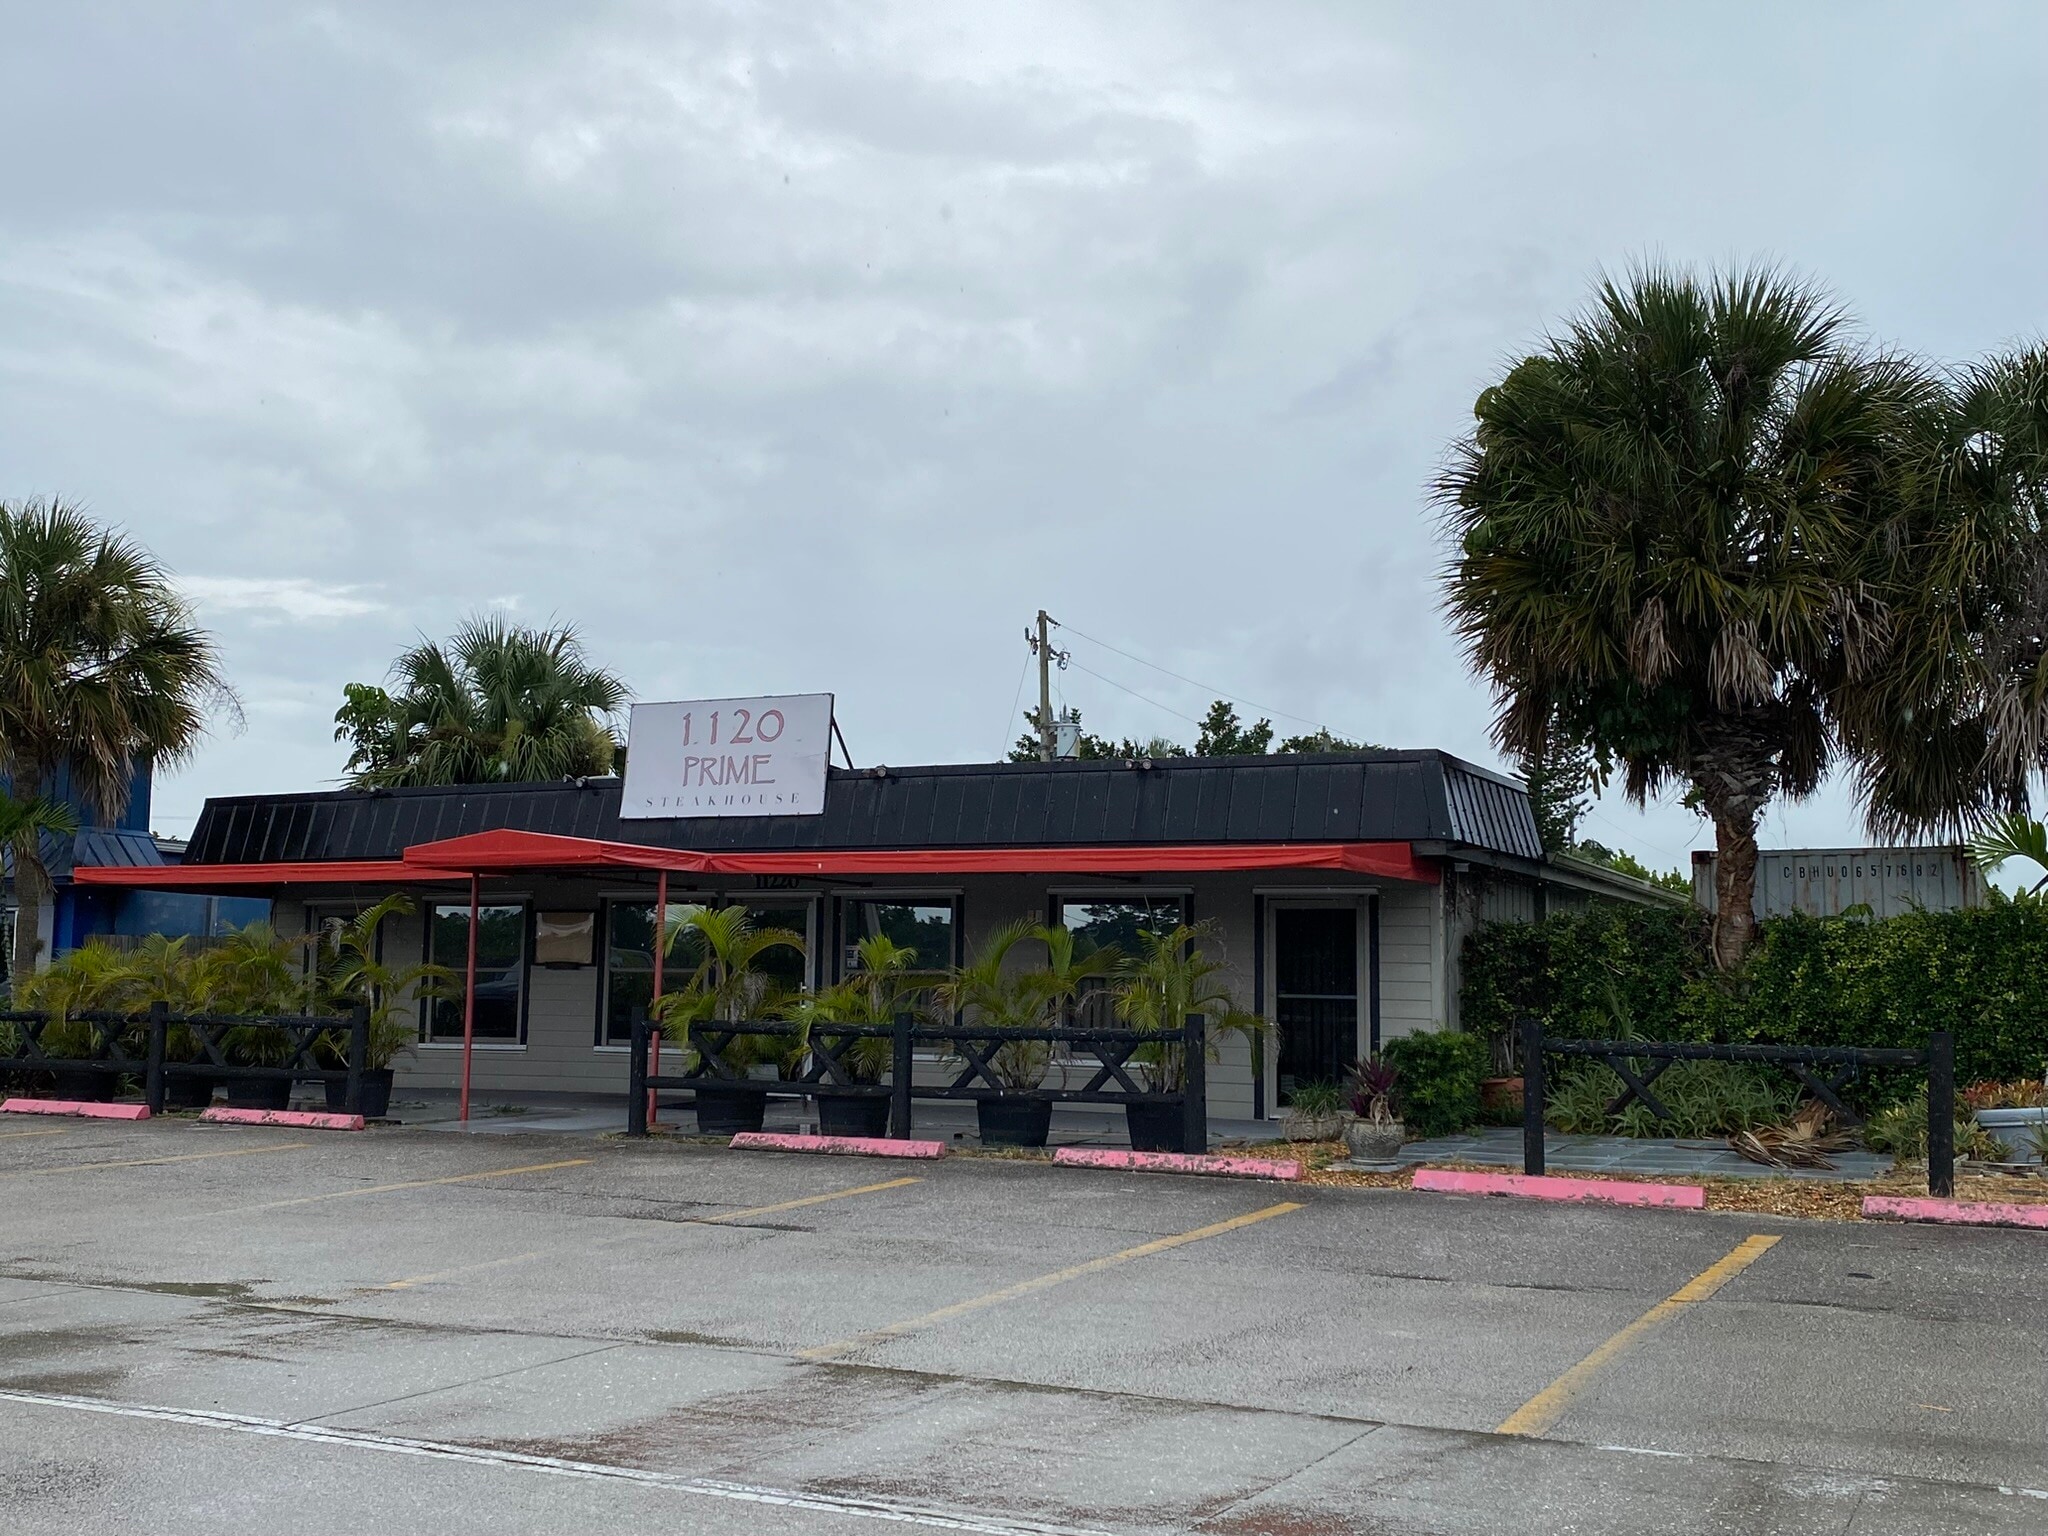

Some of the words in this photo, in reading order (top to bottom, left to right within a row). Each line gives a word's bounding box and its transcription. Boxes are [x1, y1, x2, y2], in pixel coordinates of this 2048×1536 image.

[683, 708, 785, 746] 1120
[682, 753, 776, 787] PRIME
[645, 792, 801, 808] STEAKHOUSE
